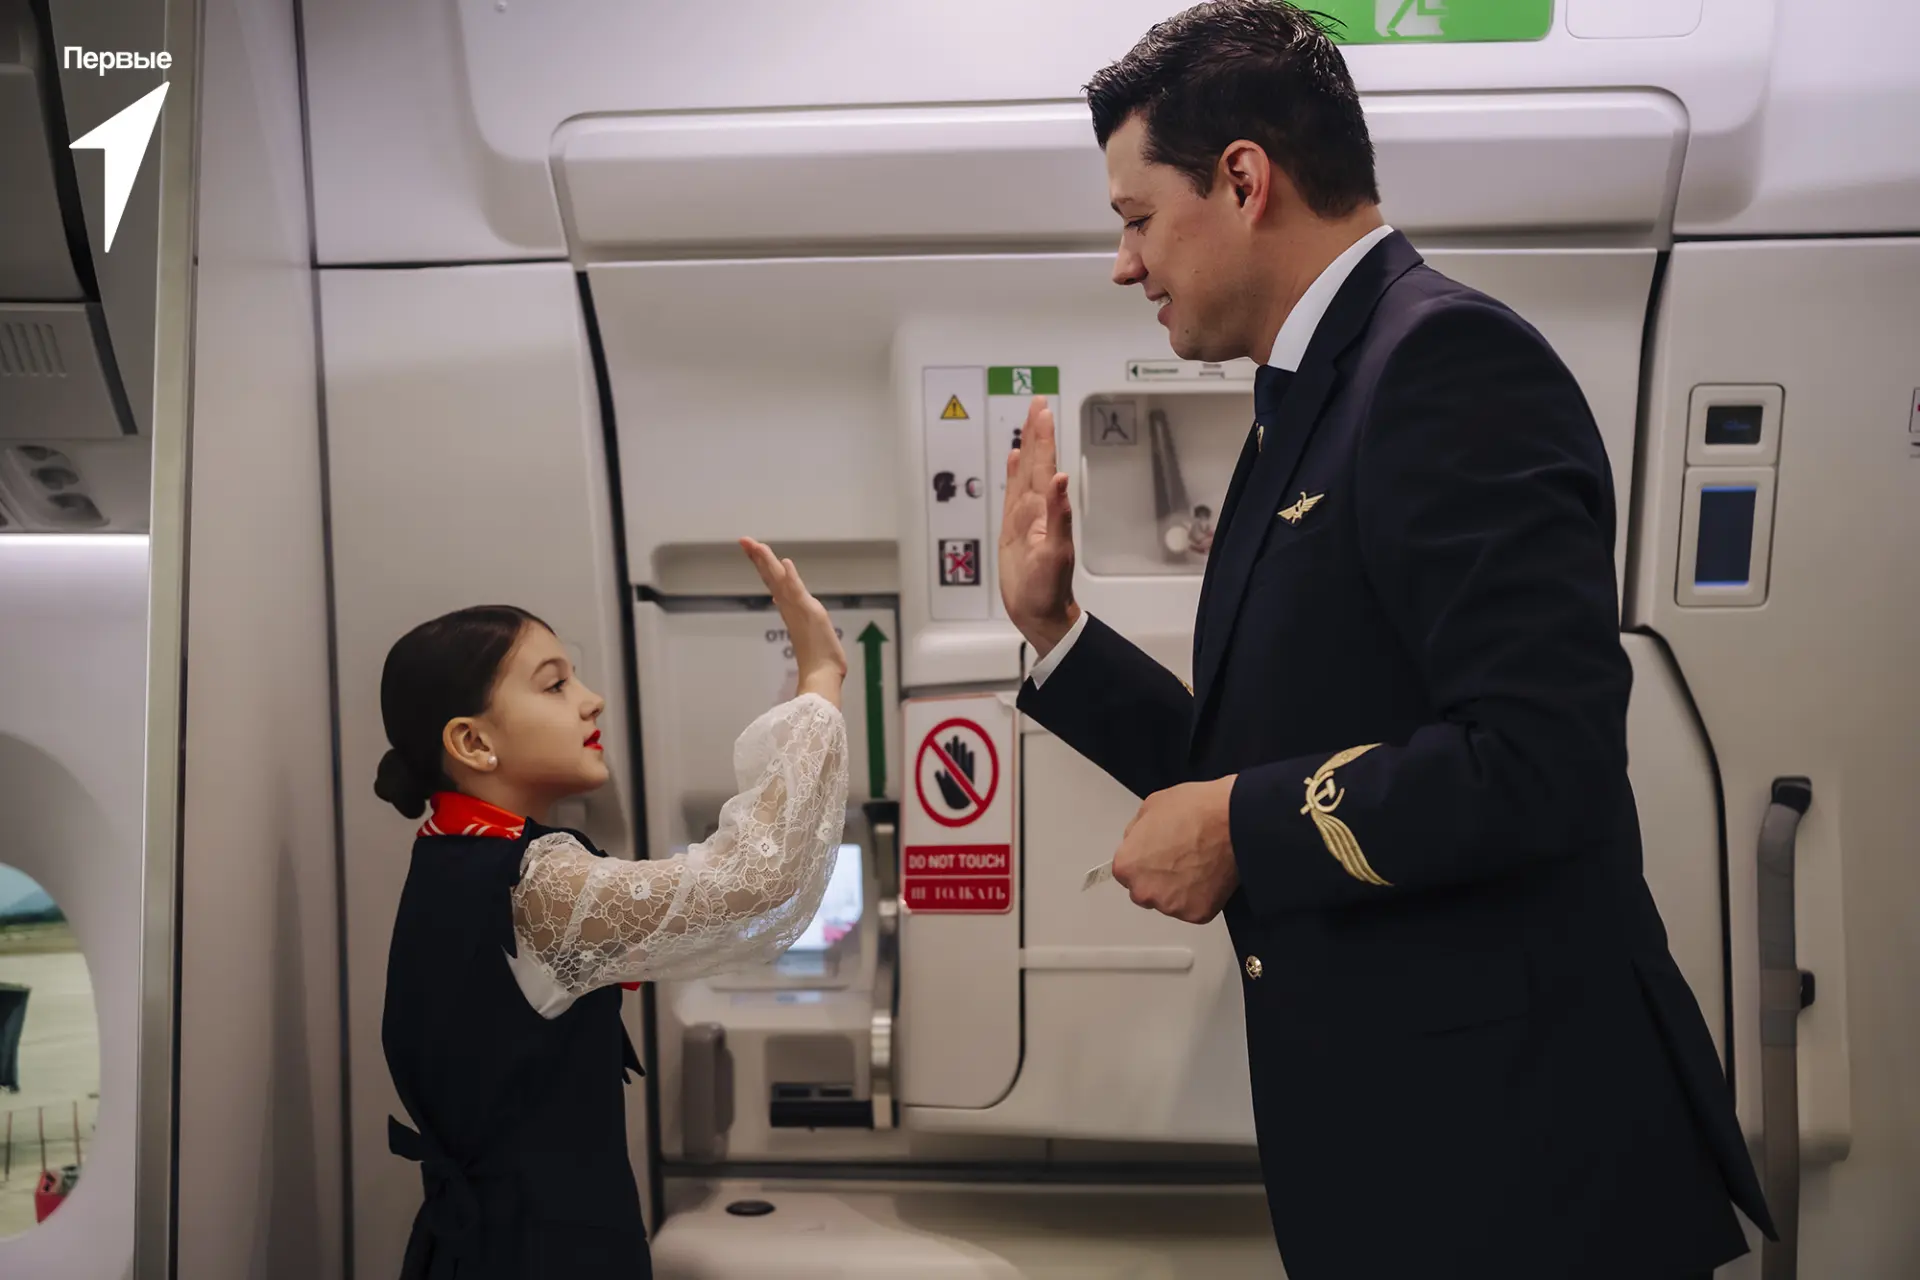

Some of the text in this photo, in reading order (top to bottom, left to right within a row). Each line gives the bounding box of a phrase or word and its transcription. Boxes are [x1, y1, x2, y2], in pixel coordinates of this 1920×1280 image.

[908, 853, 1005, 869] DO NOT TOUCH
